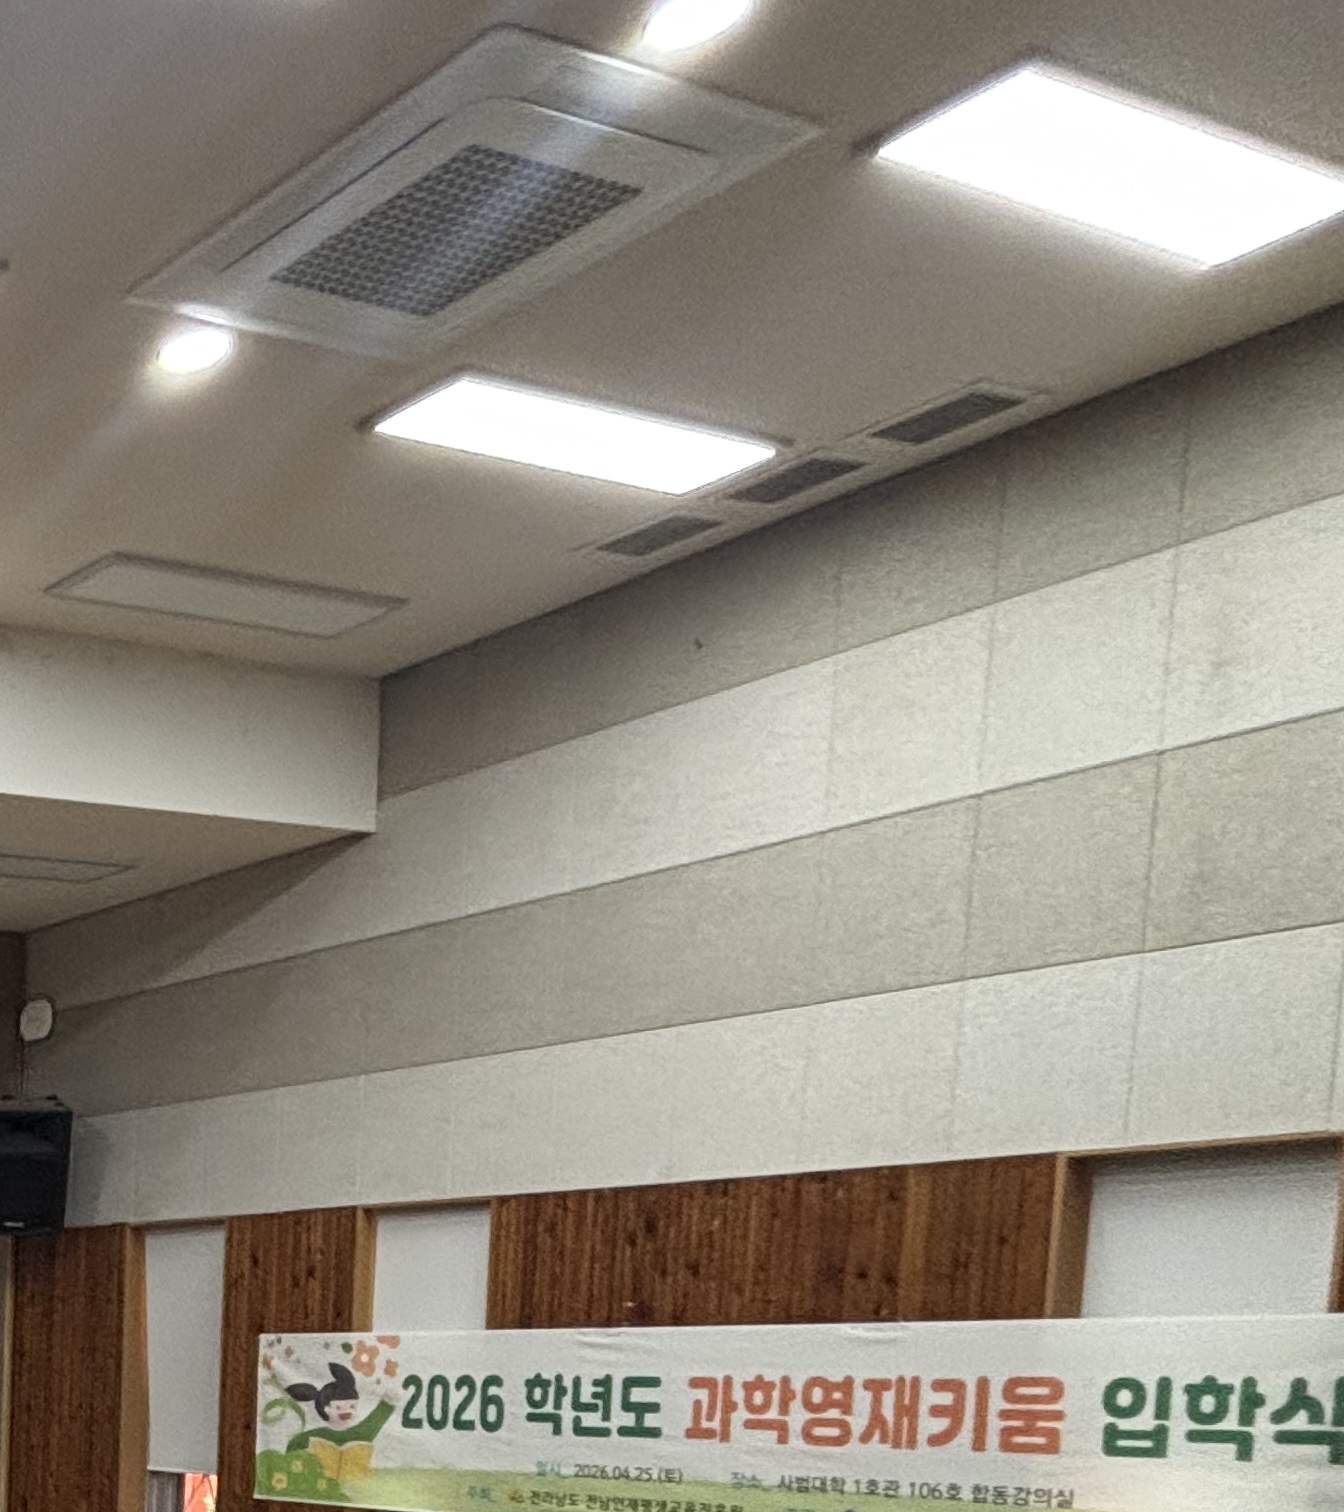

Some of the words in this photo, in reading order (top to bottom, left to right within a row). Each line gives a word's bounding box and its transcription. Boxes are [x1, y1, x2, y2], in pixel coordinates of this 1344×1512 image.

[401, 1373, 505, 1433] 2026
[524, 1371, 663, 1439] 학년도
[684, 1373, 1067, 1456] 과학영재키움
[1101, 1374, 1344, 1466] 입학식
[529, 1489, 582, 1508] 전라남도
[573, 1463, 685, 1485] 2026.04.25.(토)
[777, 1474, 846, 1495] 사범대학
[854, 1479, 901, 1498] 1호관
[909, 1482, 962, 1502] 106호
[971, 1484, 1075, 1510] 합동강의실
